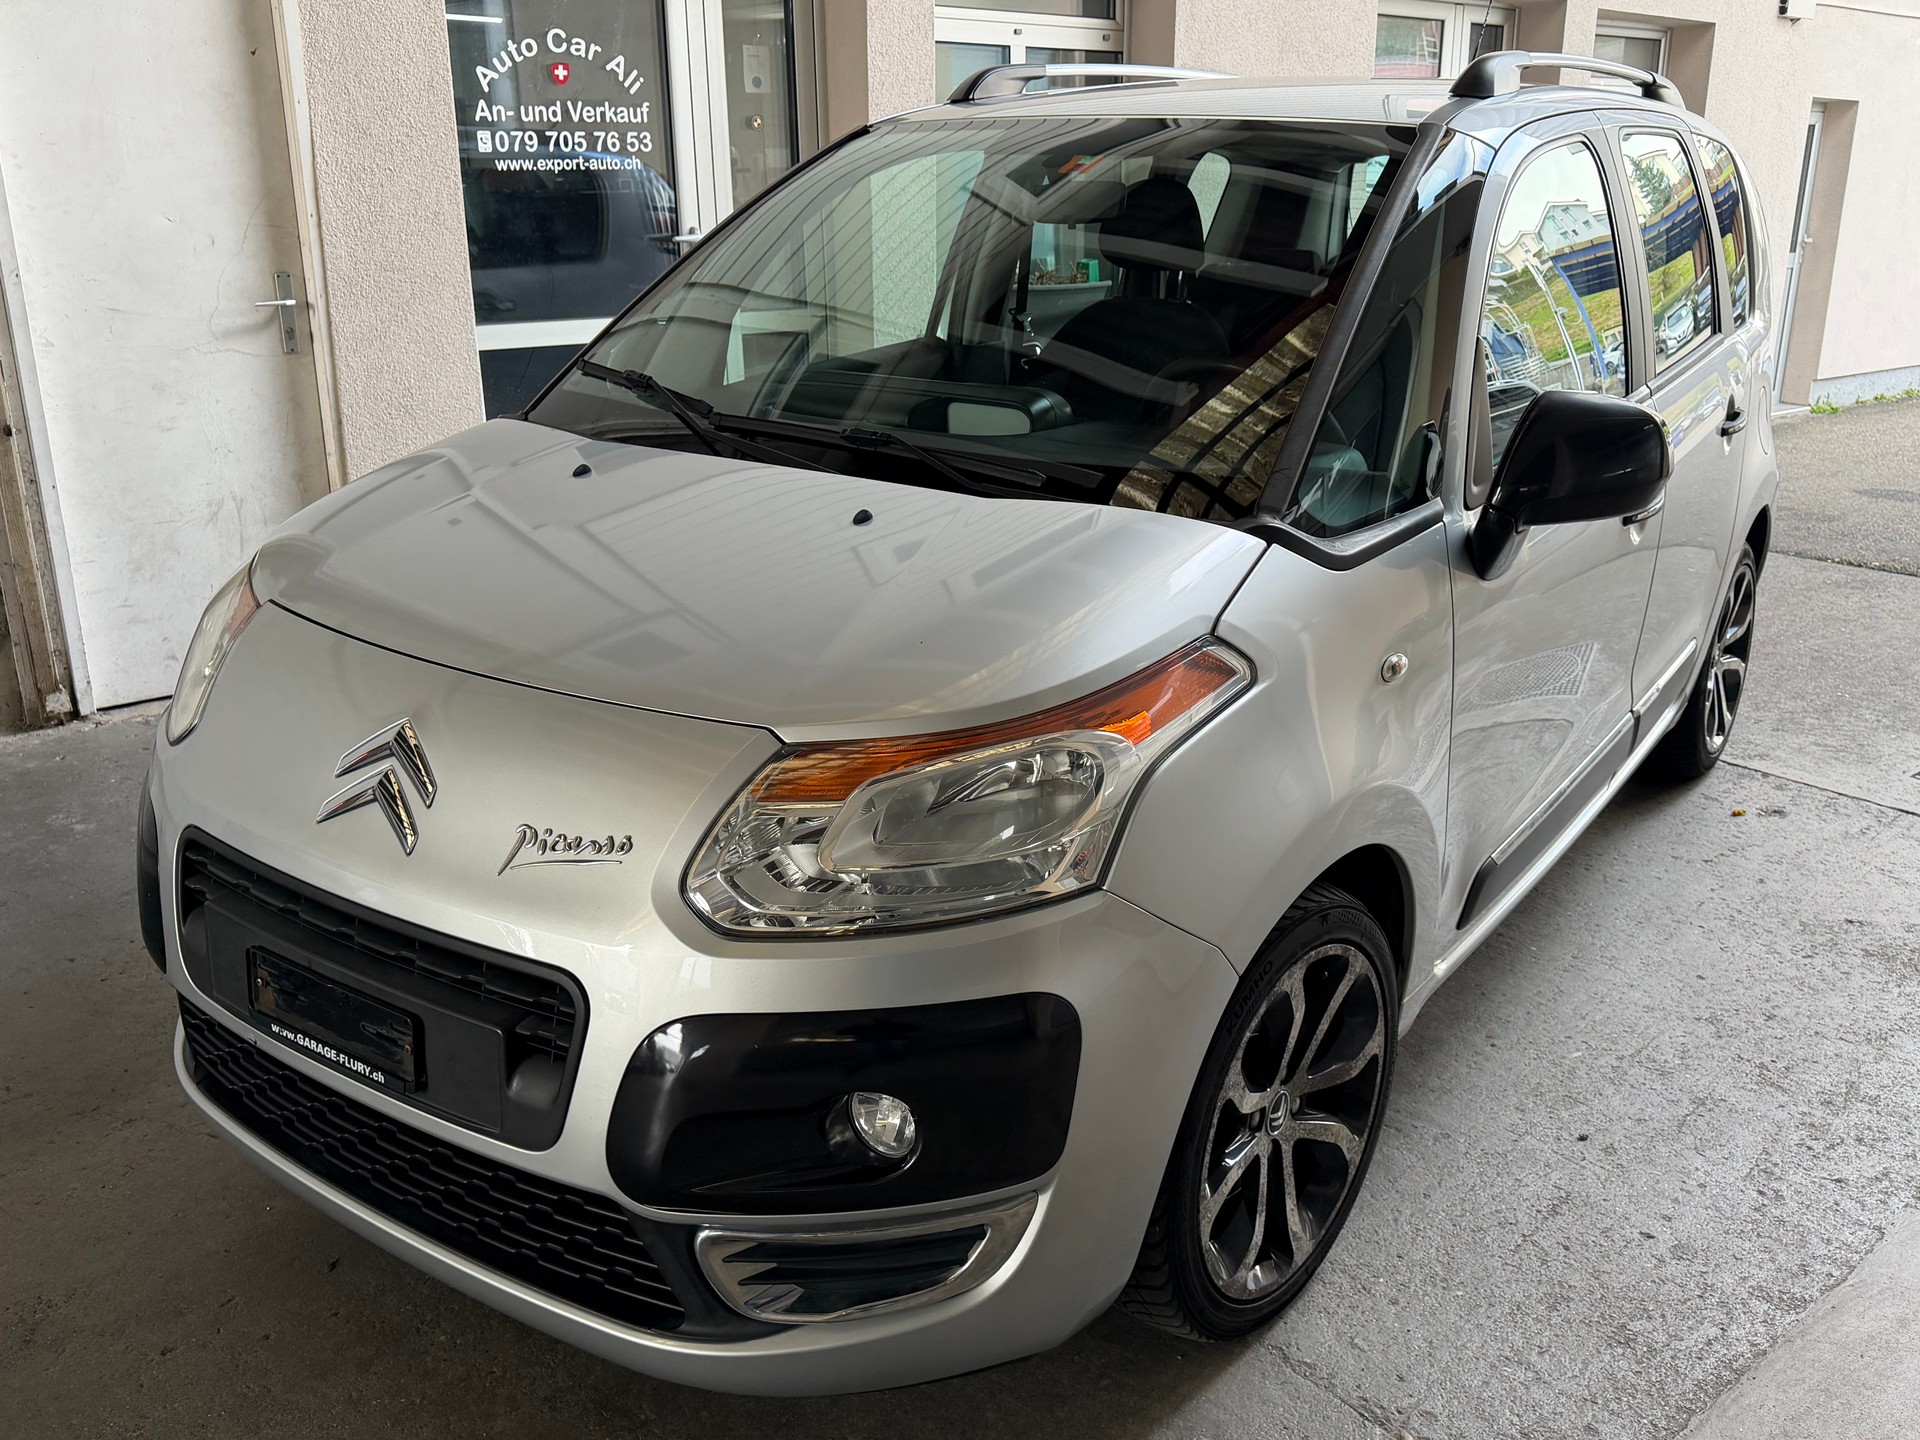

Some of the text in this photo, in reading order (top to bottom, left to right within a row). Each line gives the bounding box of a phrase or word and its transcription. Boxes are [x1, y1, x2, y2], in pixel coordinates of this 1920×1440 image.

[475, 28, 645, 95] Auto Car Ali
[475, 98, 650, 124] An- und Verkauf
[495, 131, 653, 152] 079 705 76 53
[495, 155, 641, 174] www.export-auto.ch
[496, 823, 634, 877] Picasso
[1225, 960, 1273, 1036] KUMHO
[271, 1023, 385, 1084] www.GARAGE-FLURY.ch
